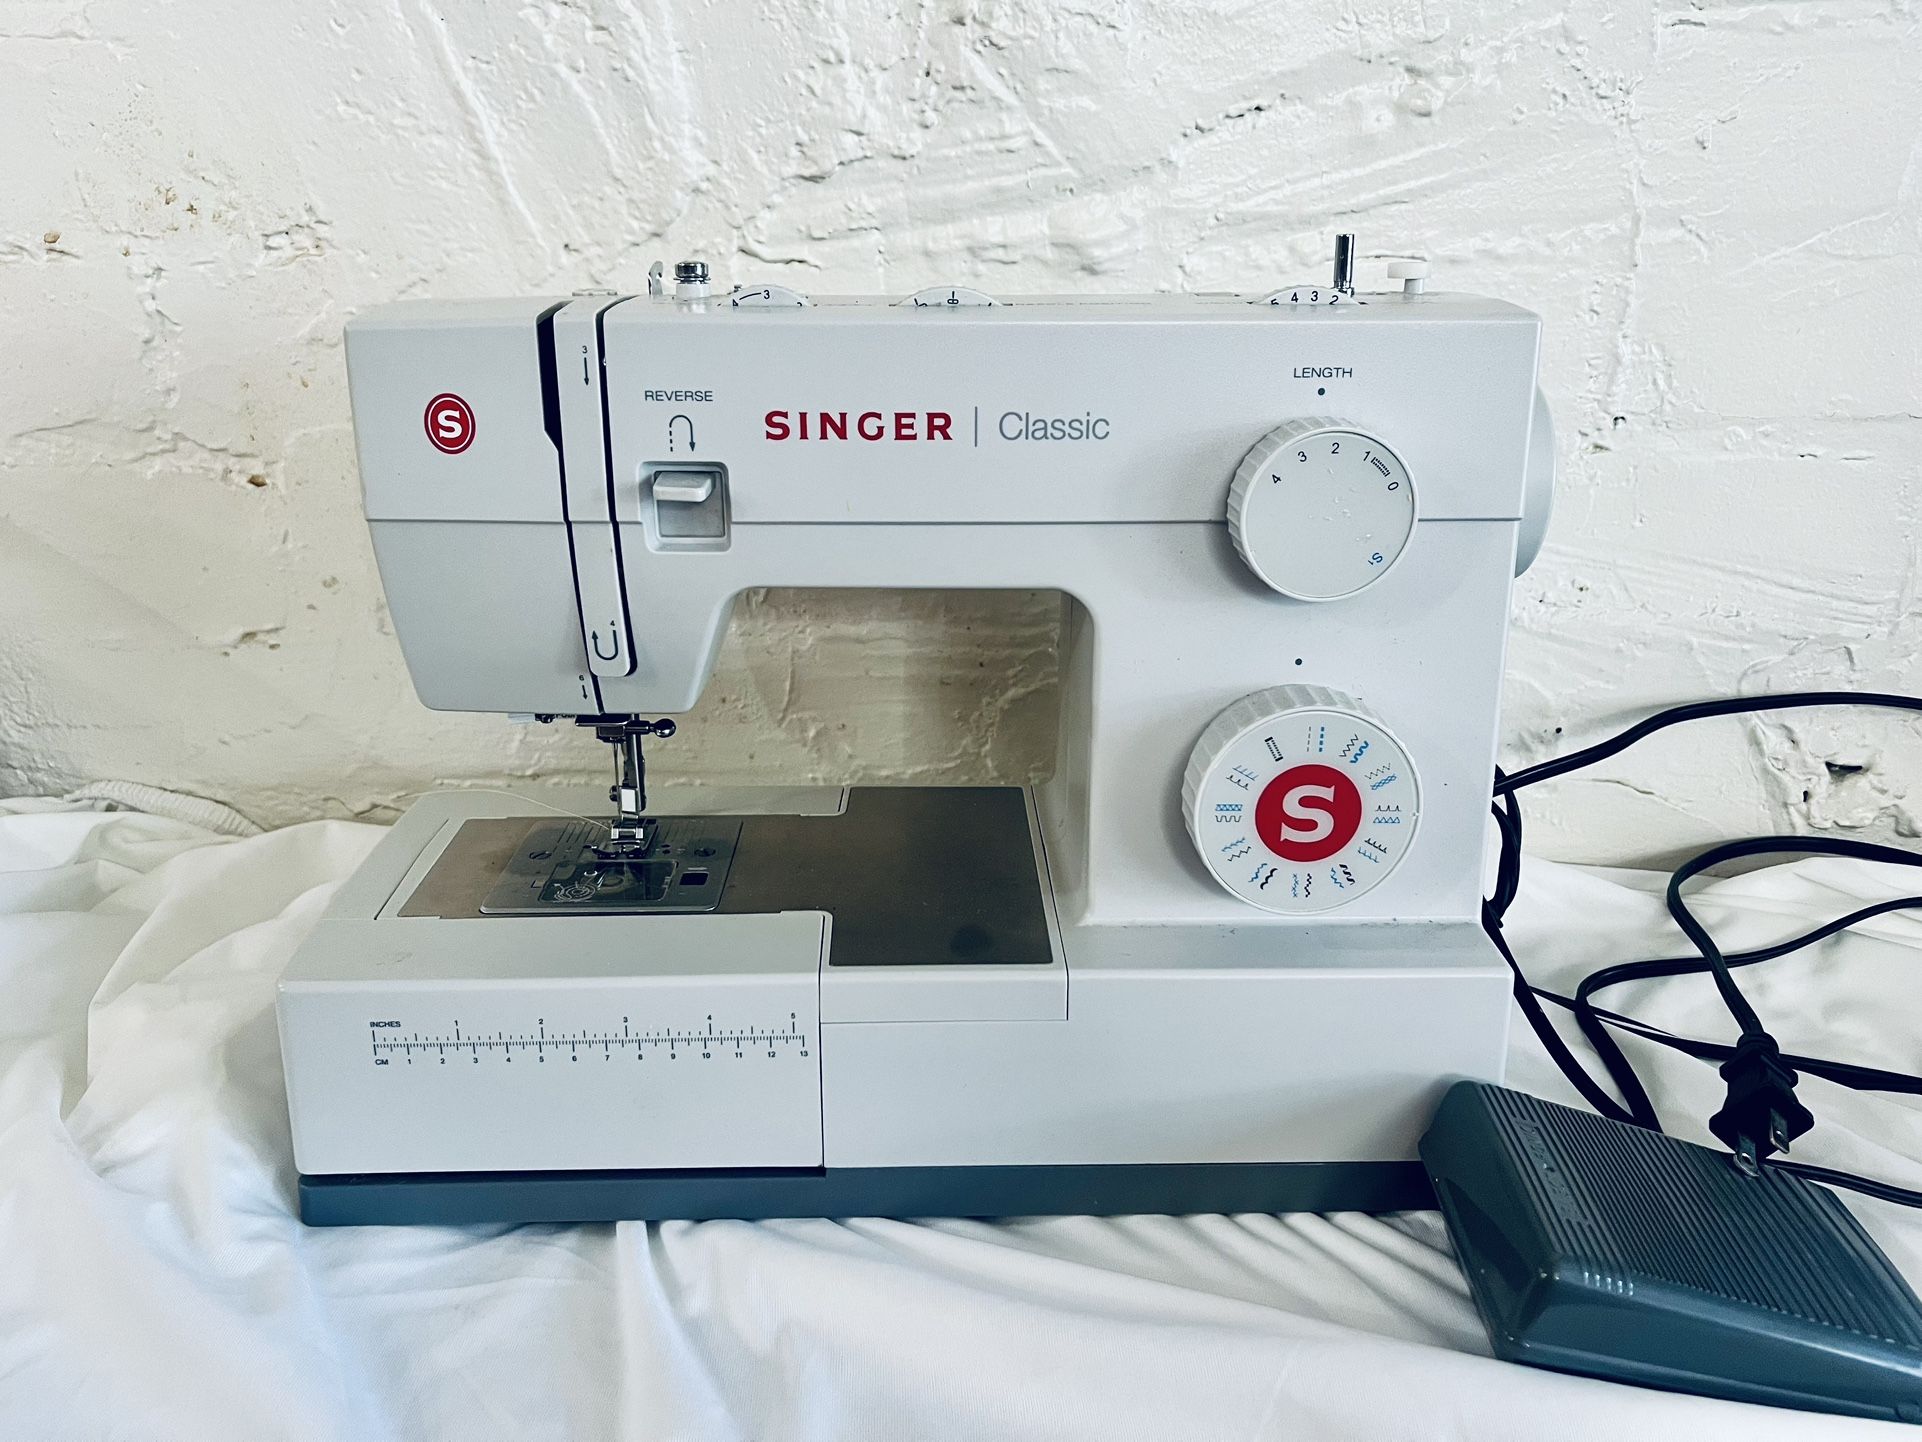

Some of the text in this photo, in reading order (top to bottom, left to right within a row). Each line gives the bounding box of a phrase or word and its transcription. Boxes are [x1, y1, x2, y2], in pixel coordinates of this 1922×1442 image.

[762, 289, 771, 301] 3
[1290, 291, 1299, 304] 4
[1310, 290, 1319, 303] 3
[1328, 294, 1340, 306] 2
[581, 344, 589, 355] 3
[1293, 366, 1354, 379] LENGTH
[643, 389, 714, 403] REVERSE
[436, 408, 464, 440] S
[763, 409, 1111, 442] SINGER Classic
[1271, 472, 1283, 486] 4
[1296, 450, 1309, 464] 3
[1330, 441, 1341, 456] 2
[1362, 449, 1372, 463] 1
[1386, 480, 1401, 493] 0
[609, 619, 617, 628] 4
[577, 673, 586, 683] 6
[1279, 783, 1336, 844] S
[368, 1012, 797, 1029] INCHES 1 2 3 4 5
[374, 1050, 809, 1066] CM 1 2 3 4 5 6 7 8 9 10 11 12 13
